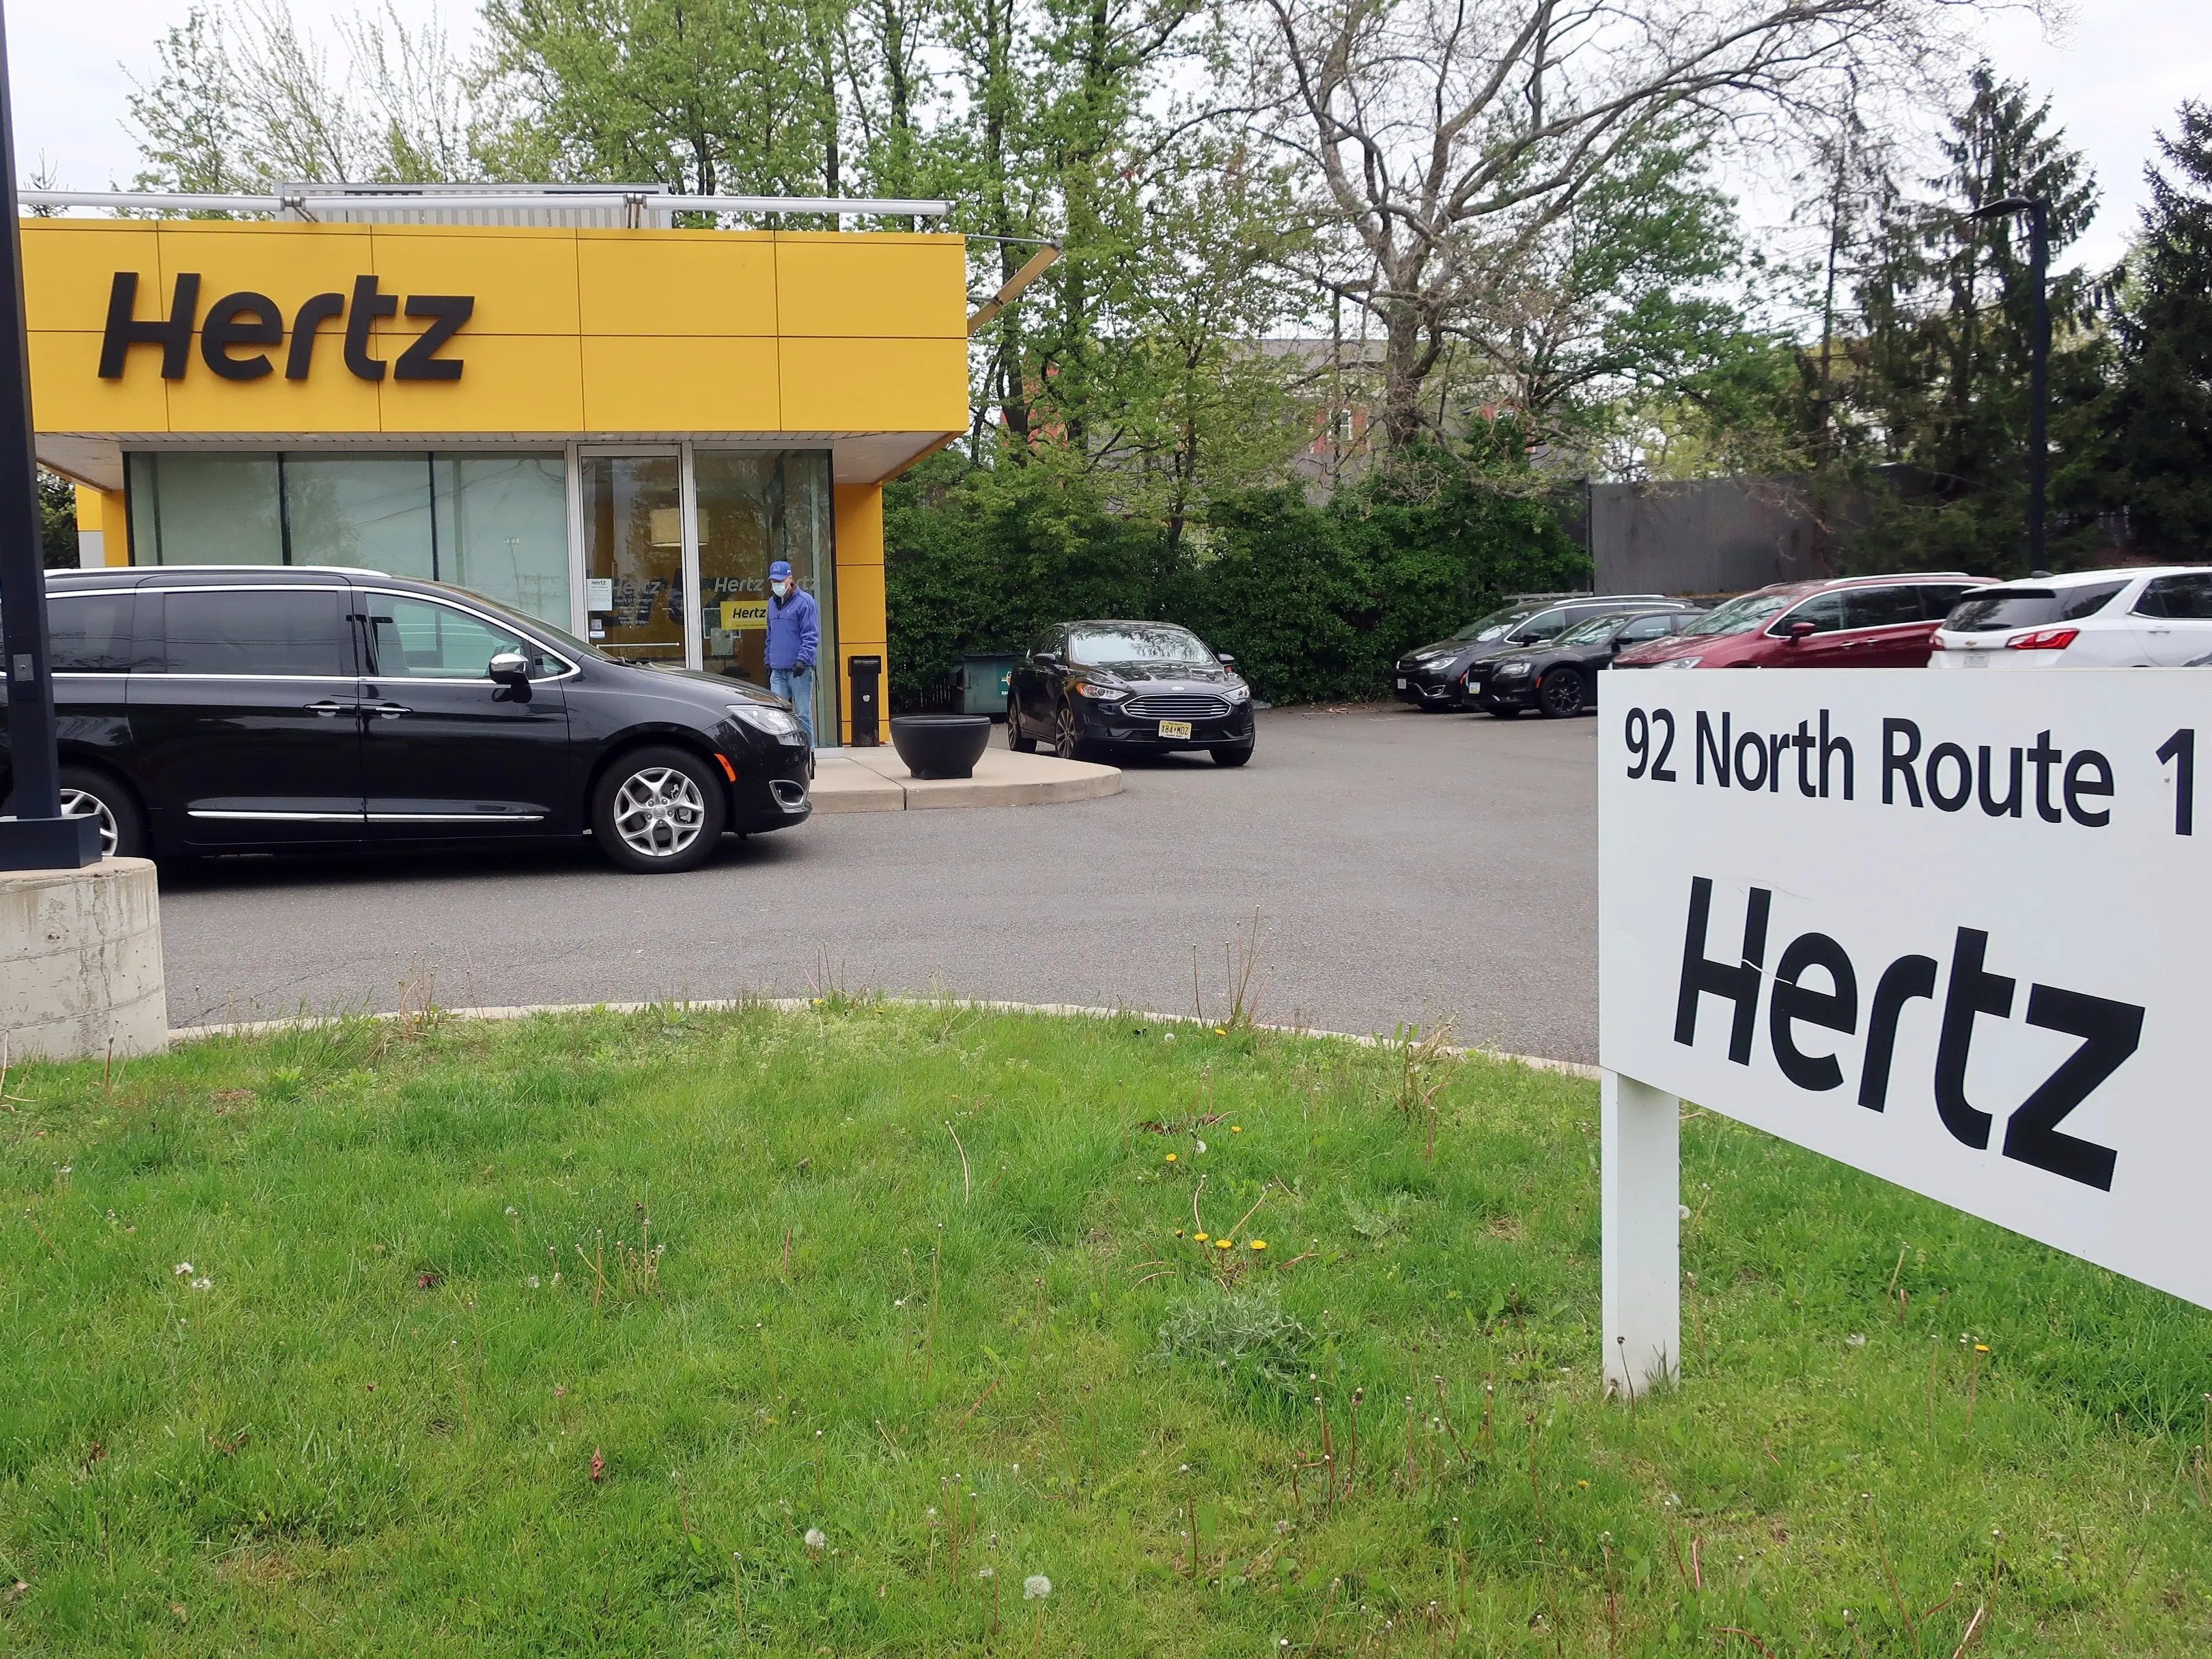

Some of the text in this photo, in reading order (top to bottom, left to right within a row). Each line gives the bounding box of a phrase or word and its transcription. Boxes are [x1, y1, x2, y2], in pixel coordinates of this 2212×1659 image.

[98, 271, 475, 381] Hertz
[613, 578, 661, 596] Hetz
[714, 576, 765, 592] Hertz
[732, 607, 767, 619] Hertz
[1624, 706, 2195, 837] 92 North Route 1
[1673, 876, 2146, 1193] Hertz
